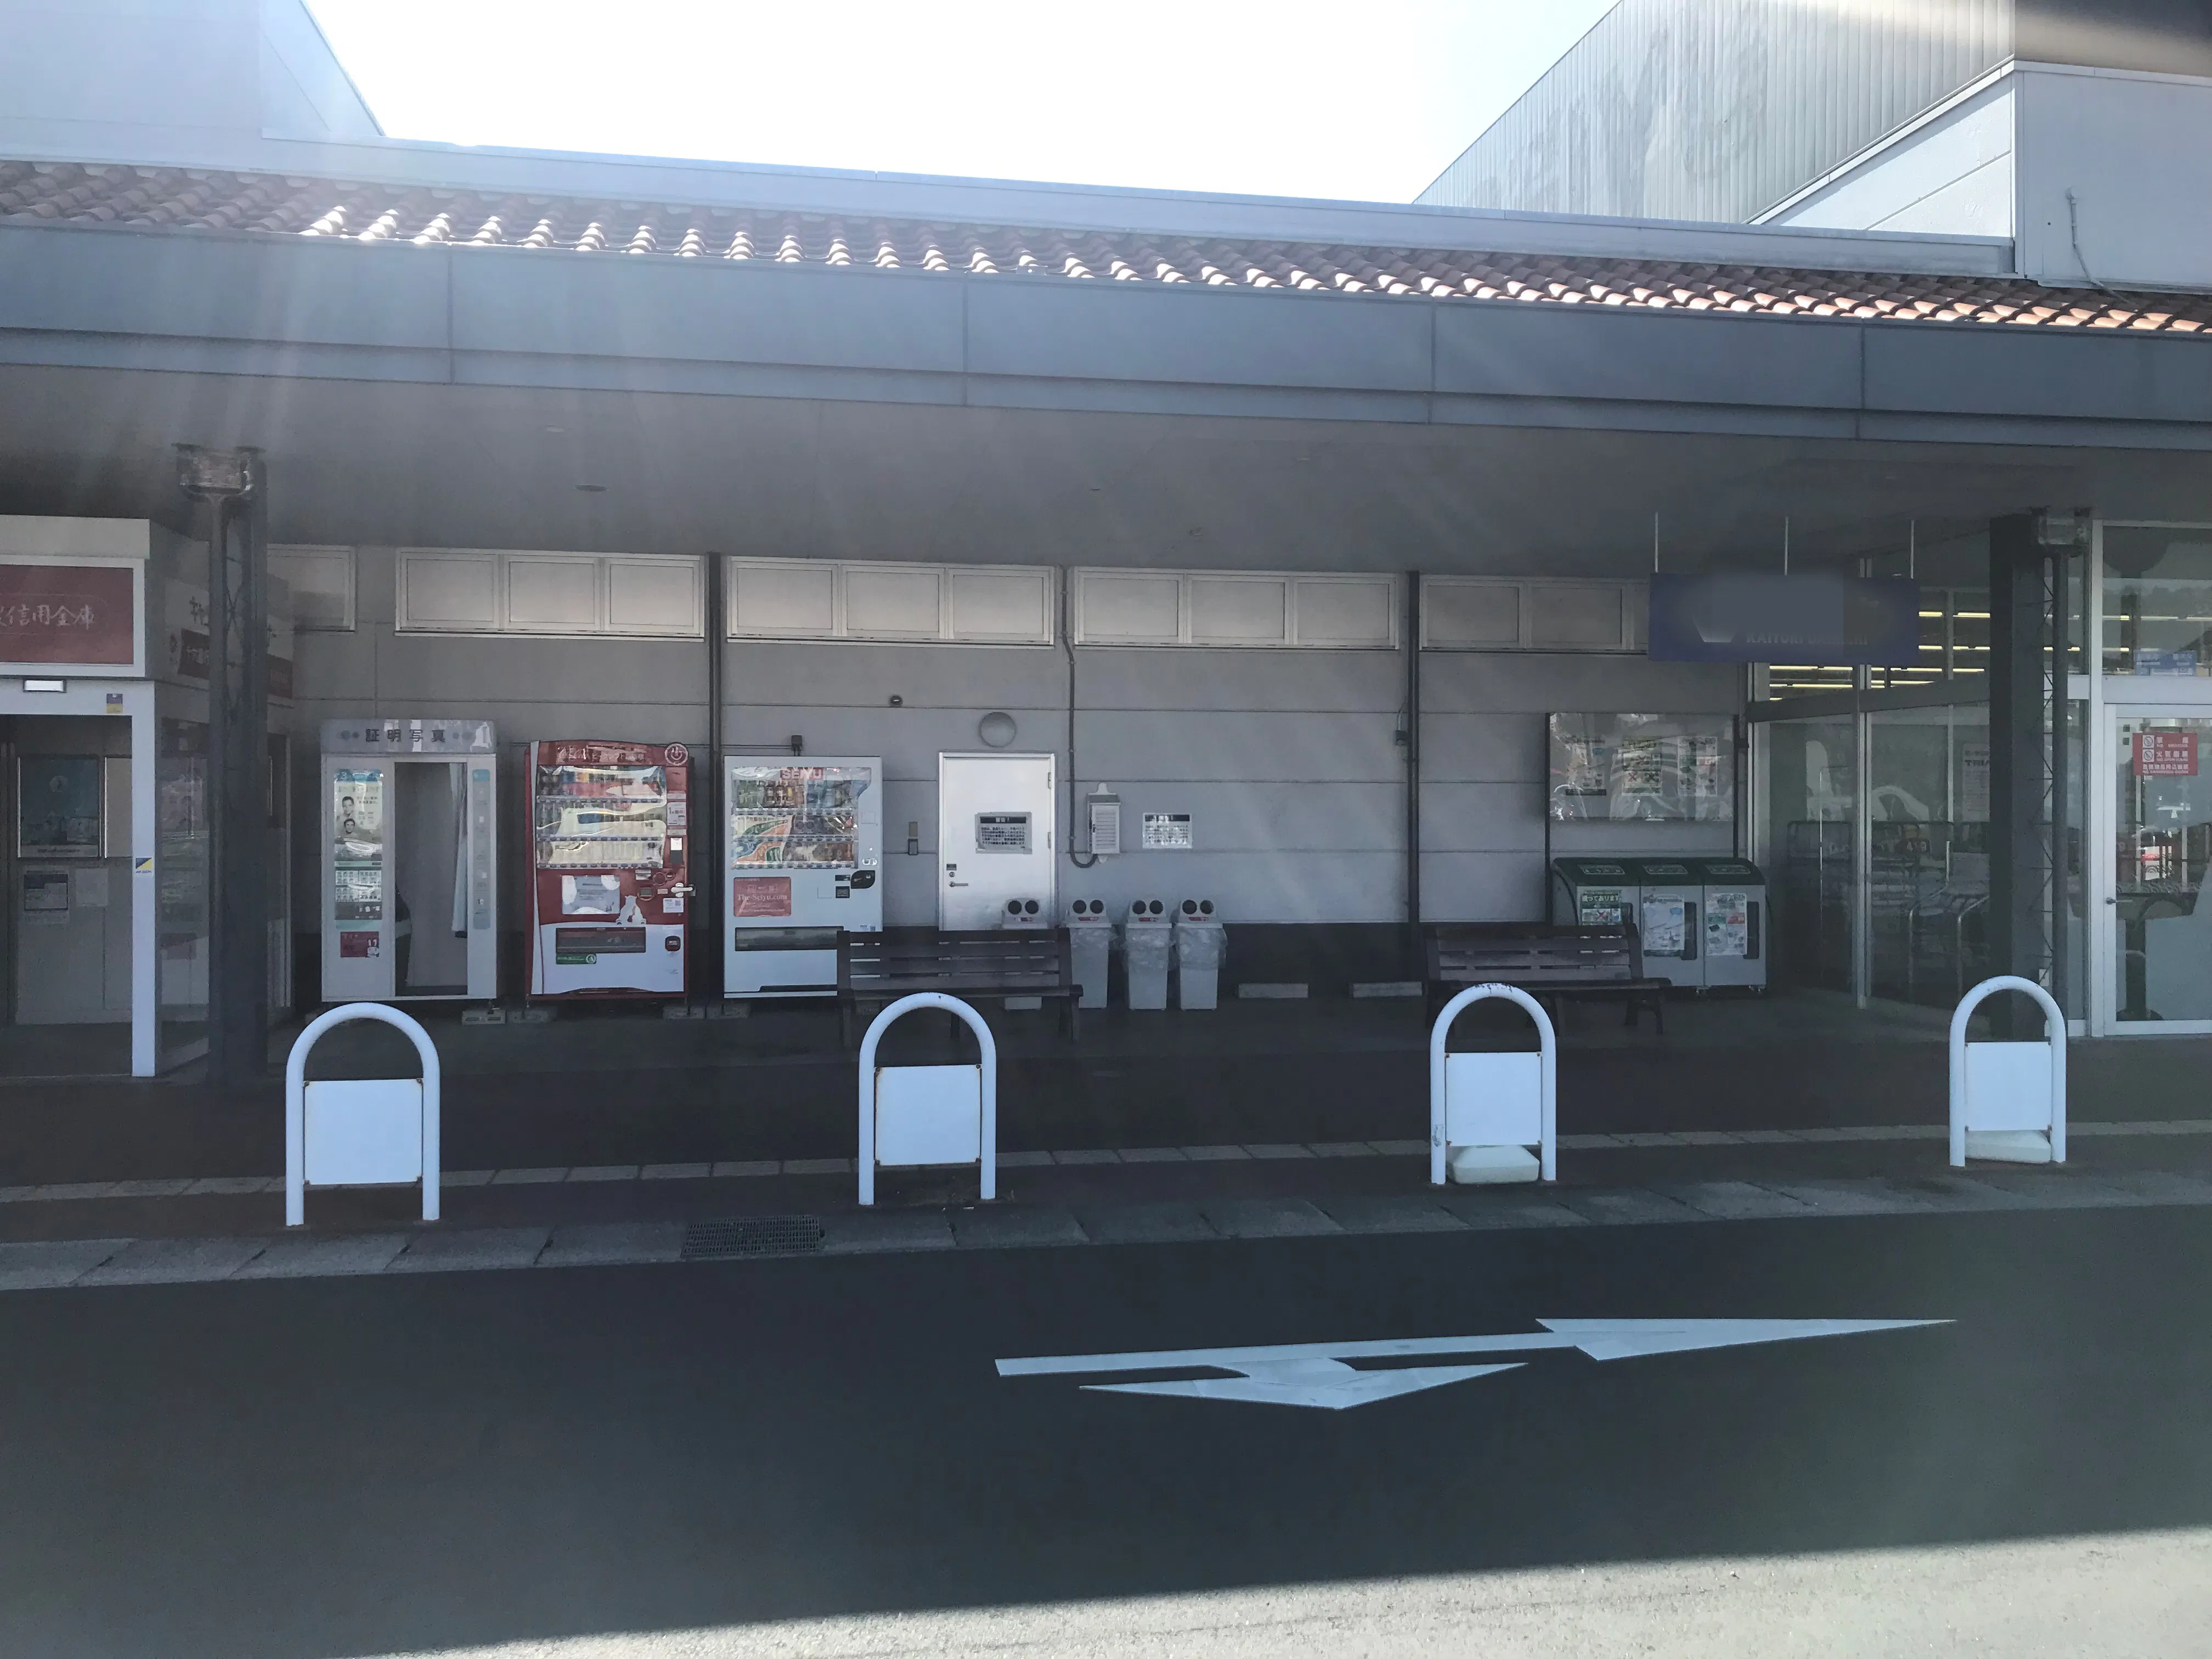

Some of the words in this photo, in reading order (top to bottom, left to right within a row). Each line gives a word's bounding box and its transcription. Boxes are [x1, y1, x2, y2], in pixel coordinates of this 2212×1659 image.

[365, 728, 446, 742] 証明写真
[781, 768, 822, 779] SEIYU
